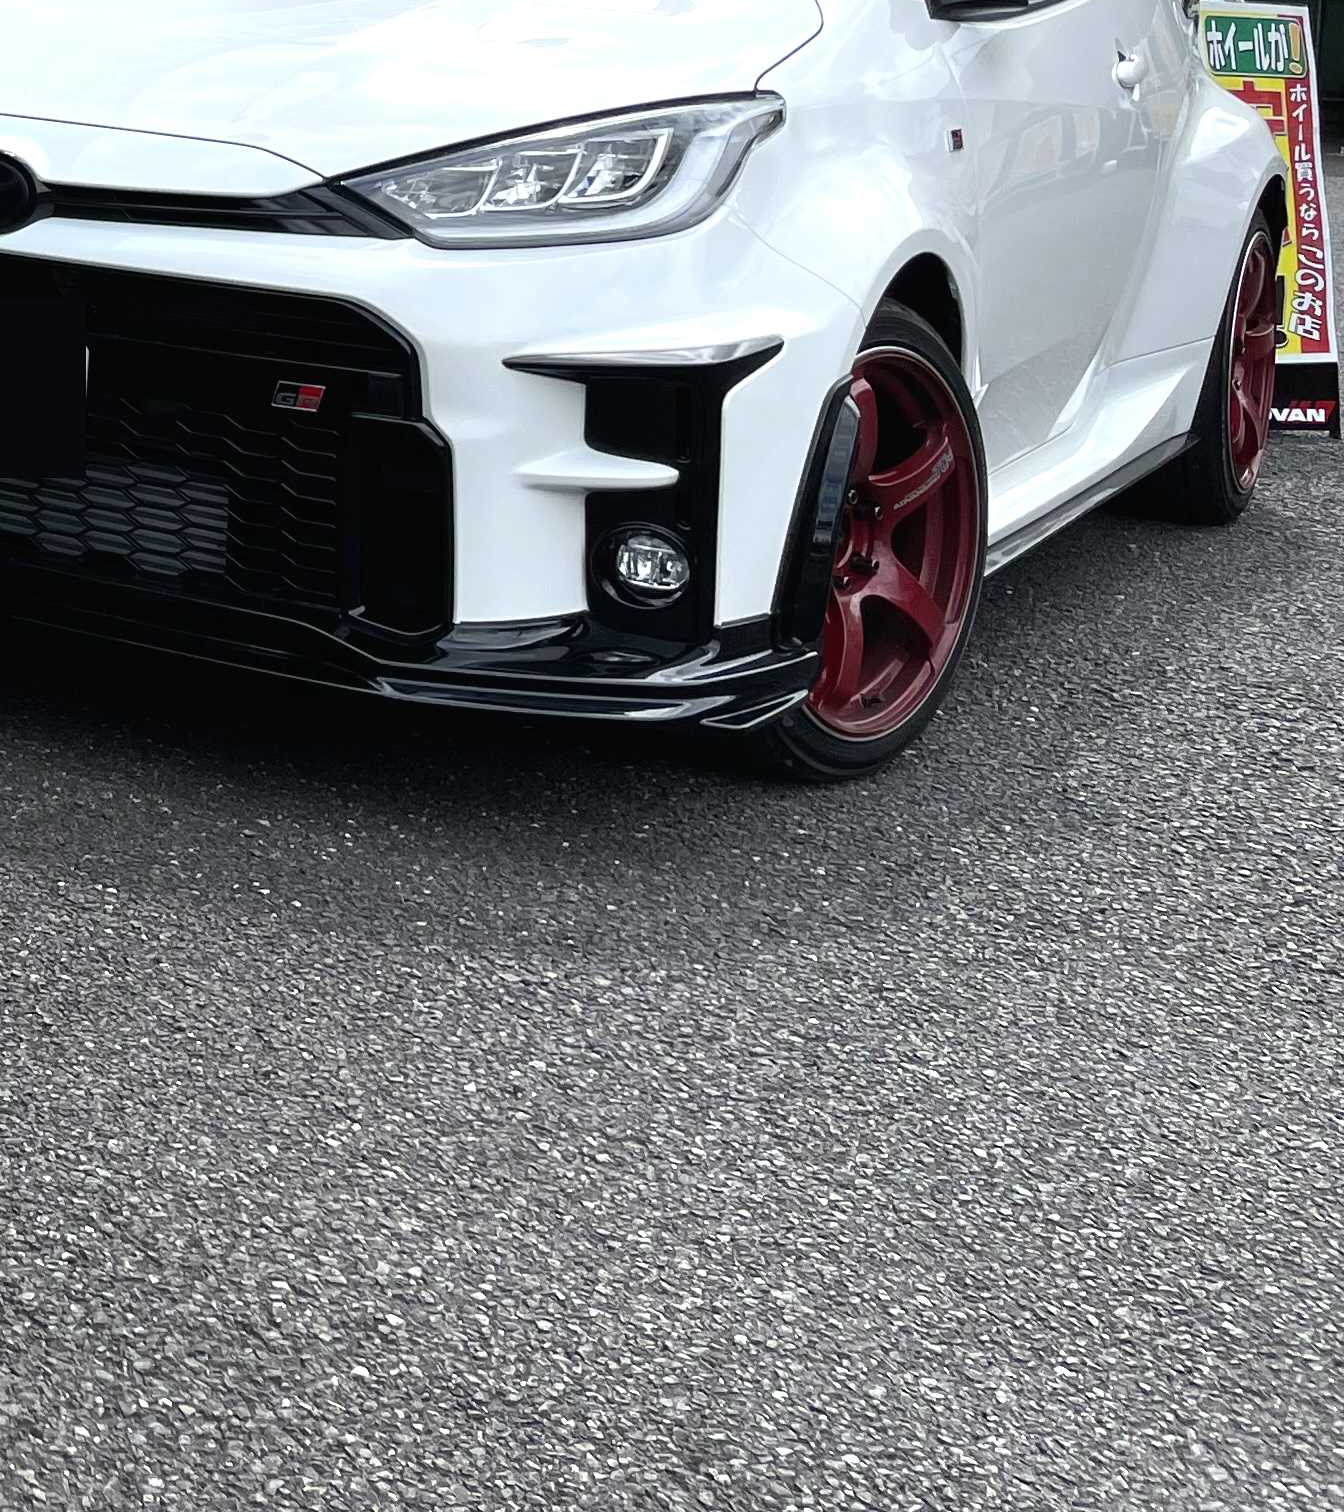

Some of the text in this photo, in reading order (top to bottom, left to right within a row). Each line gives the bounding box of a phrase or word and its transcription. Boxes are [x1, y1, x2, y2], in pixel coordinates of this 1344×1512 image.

[1206, 19, 1304, 75] ホイールが!
[1268, 407, 1327, 424] VAN
